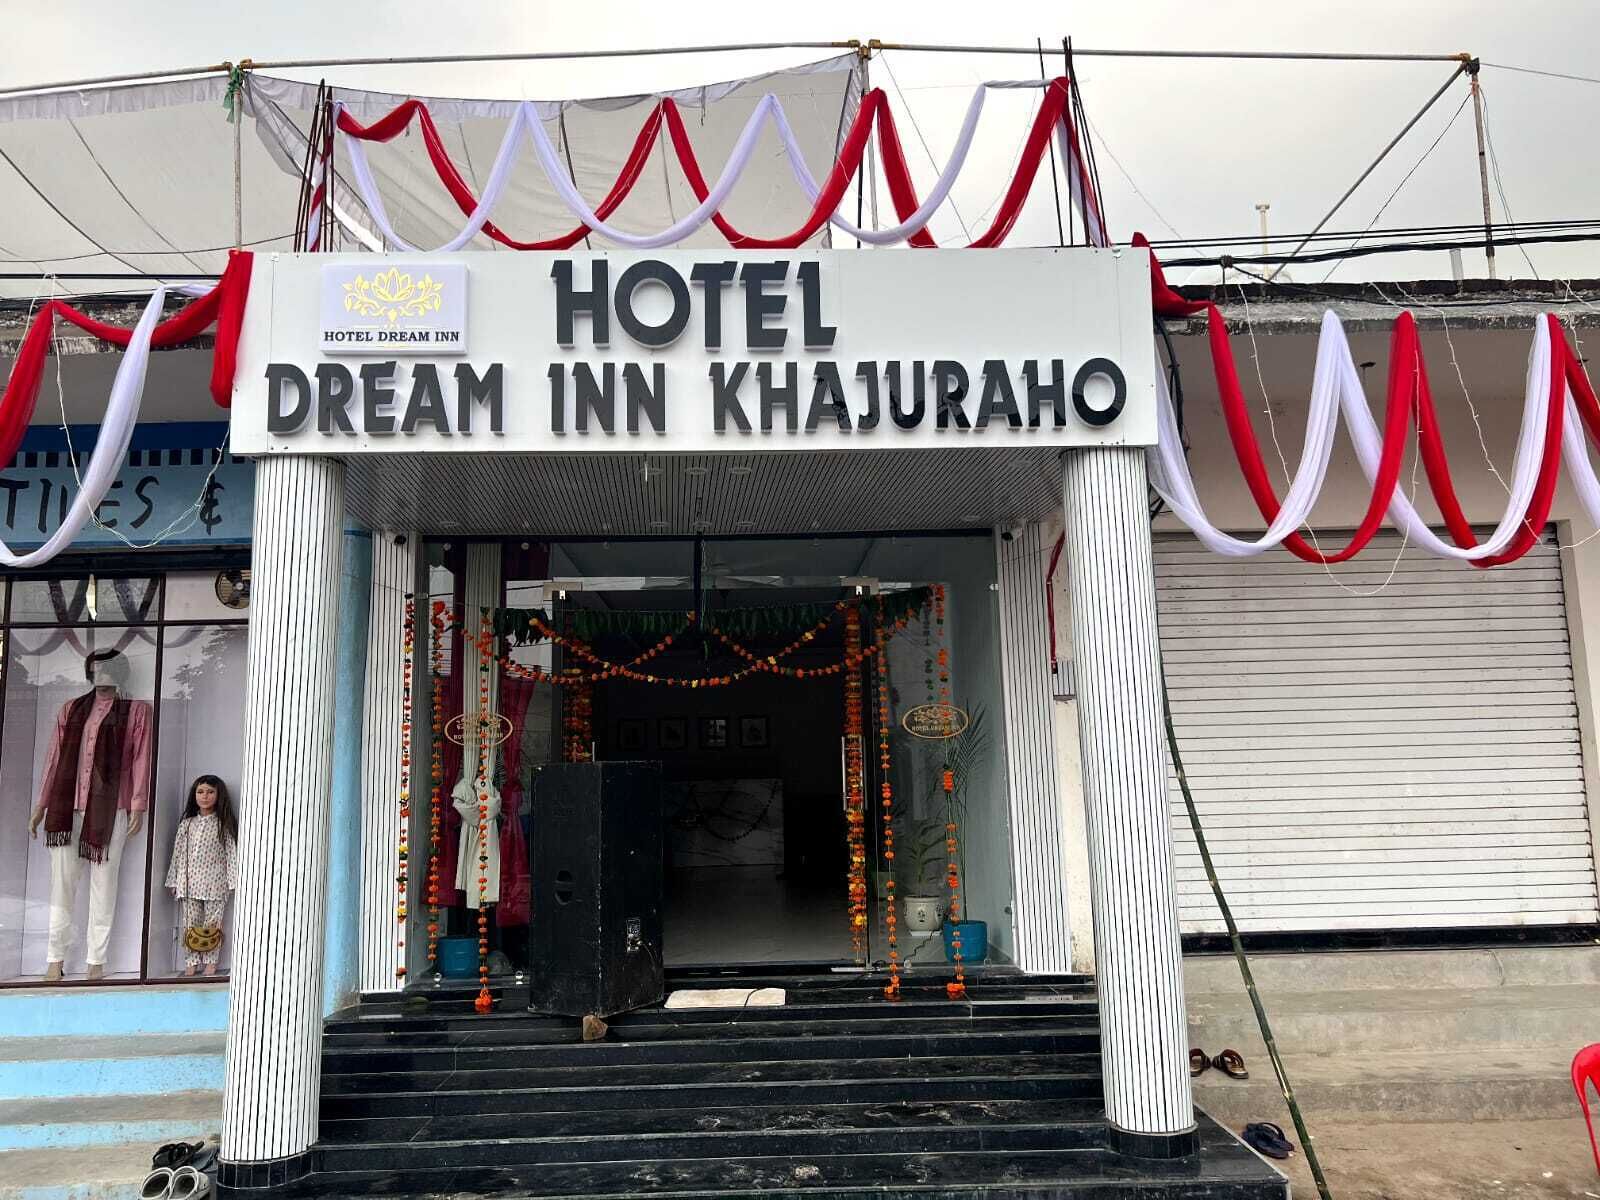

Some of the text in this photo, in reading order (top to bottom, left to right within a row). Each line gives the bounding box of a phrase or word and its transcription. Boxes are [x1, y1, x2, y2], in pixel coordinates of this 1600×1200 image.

[324, 331, 460, 342] HOTEL DREAM INN
[550, 259, 837, 349] HOTEL
[264, 357, 1127, 435] DREAM INN KHAJURAHO
